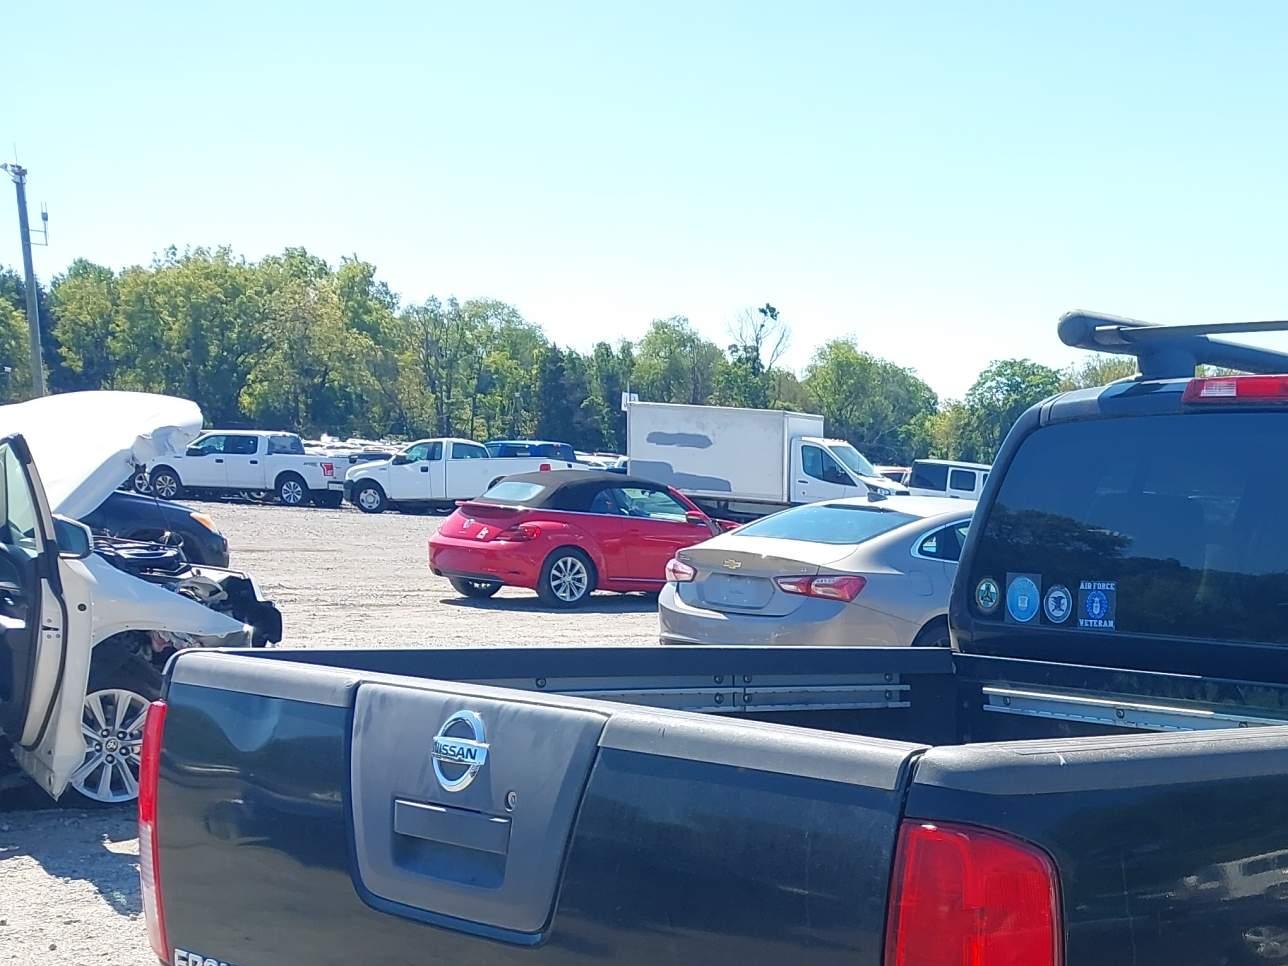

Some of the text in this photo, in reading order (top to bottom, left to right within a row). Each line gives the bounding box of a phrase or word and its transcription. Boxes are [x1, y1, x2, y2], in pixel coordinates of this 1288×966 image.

[1080, 581, 1092, 590] AIR
[1079, 618, 1114, 628] VETERAN
[433, 741, 477, 760] NISSAN
